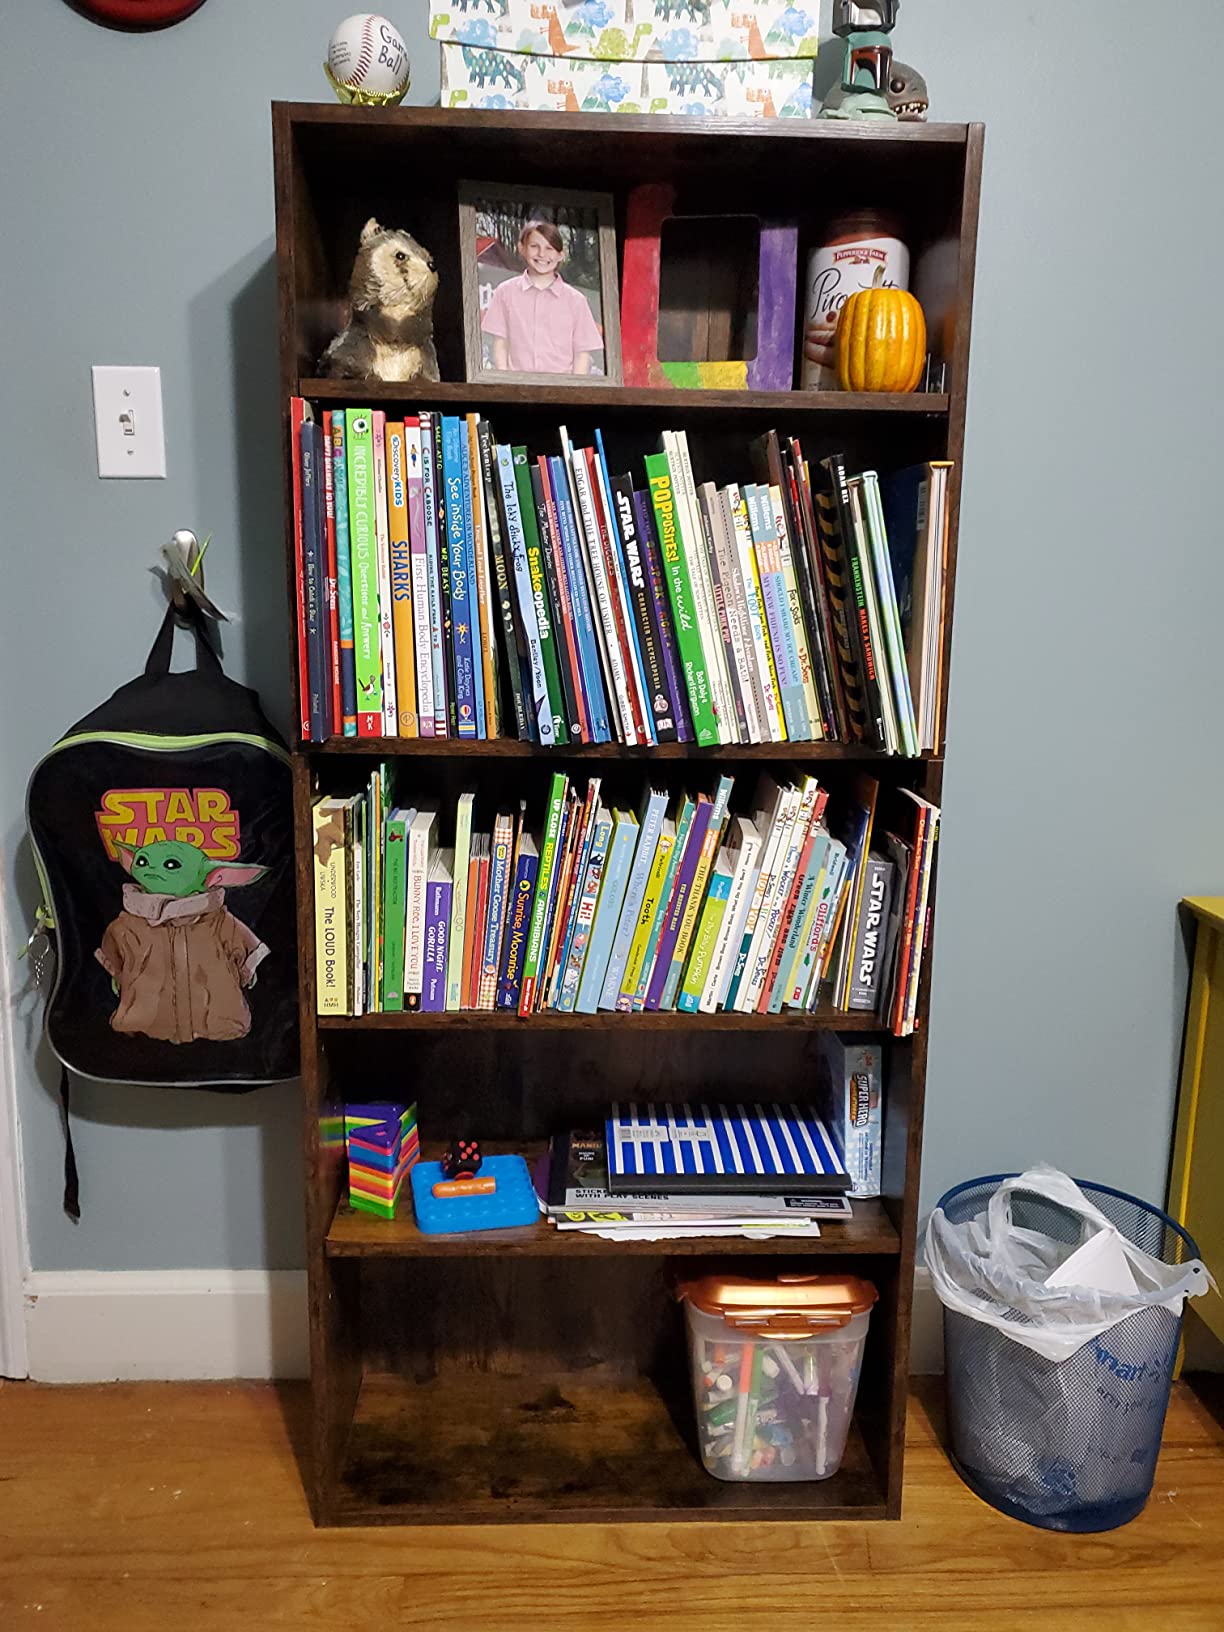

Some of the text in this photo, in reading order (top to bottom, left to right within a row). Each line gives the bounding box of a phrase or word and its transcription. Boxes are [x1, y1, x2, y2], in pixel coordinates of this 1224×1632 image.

[378, 45, 402, 75] Ball
[870, 249, 885, 260] FARM
[423, 456, 429, 464] IS
[481, 433, 492, 483] Teckentrup
[354, 446, 368, 509] INCREDIBLY
[504, 482, 514, 499] The
[838, 466, 846, 487] ADAM
[424, 486, 433, 527] CABOOSE
[506, 504, 518, 522] Icky
[748, 496, 759, 532] Willems
[760, 495, 773, 531] Willems
[356, 511, 369, 559] CURIOUS
[448, 478, 466, 600] See inside Your Body
[463, 474, 471, 522] ADVENTURES
[467, 533, 475, 585] WONDERLAND
[616, 490, 644, 588] STAR WARS
[575, 468, 612, 635] EDGAR and THE TREE HOUSE OF USHER
[650, 476, 692, 631] POPPOSITES! In the wild
[717, 548, 726, 567] The
[358, 562, 370, 605] Questions
[392, 541, 409, 601] SHARKS
[441, 567, 449, 595] BEAST
[495, 554, 508, 591] MOON
[763, 576, 769, 588] MY
[528, 547, 550, 639] Snakeopedia
[721, 572, 733, 607] Pigeon
[765, 592, 774, 610] NEW
[775, 576, 785, 603] SHOULD
[714, 584, 731, 643] LITTLE PINK PUP
[729, 610, 740, 643] Needs
[769, 612, 779, 643] FRIEND
[851, 557, 864, 607] FRANKENSTEIN
[859, 609, 868, 634] MAKES
[864, 643, 875, 680] SANDWICH
[415, 558, 430, 713] First Human Body Encyclopedia
[637, 592, 660, 690] CHARACTER ENCYCLOPEDIA
[784, 632, 790, 641] MY
[785, 643, 793, 654] ICE
[612, 659, 621, 680] ADAMS
[738, 658, 749, 683] Bath!
[777, 654, 783, 664] SO
[778, 667, 787, 685] FUN!
[688, 687, 700, 716] Ferguson
[99, 791, 235, 824] STAR
[553, 799, 560, 811] UP
[713, 789, 728, 820] Willems
[549, 813, 559, 839] CLOSE
[647, 809, 659, 833] PETER
[101, 827, 238, 858] WARS
[640, 835, 654, 864] RABBIT
[494, 860, 504, 893] Mother
[540, 842, 554, 890] REPTILES
[580, 826, 609, 920] Long Hi!
[830, 852, 840, 875] Bridwell
[413, 875, 421, 904] BUNNY
[794, 874, 805, 899] Green
[801, 884, 813, 906] Winter
[491, 894, 502, 921] Goose
[640, 898, 654, 925] Tooth
[677, 865, 707, 955] THE THANK YOU BOOK
[411, 931, 419, 950] LOVE
[438, 921, 446, 944] GOOD
[487, 923, 499, 963] Treasury
[506, 893, 529, 980] Sunrise, Moonrise
[529, 899, 545, 962] AMPHIBIANS
[789, 908, 806, 949] Wonderland
[810, 903, 828, 952] Clifford's
[859, 873, 884, 987] STAR WARS
[324, 907, 336, 988] The LOUD Book!
[426, 927, 435, 962] GORILLA
[775, 947, 785, 966] Ham
[410, 953, 418, 969] YOU
[734, 962, 744, 976] Seuss
[751, 957, 767, 986] Dr. Seuss
[856, 1075, 869, 1102] SUPER
[856, 1104, 868, 1126] HERO
